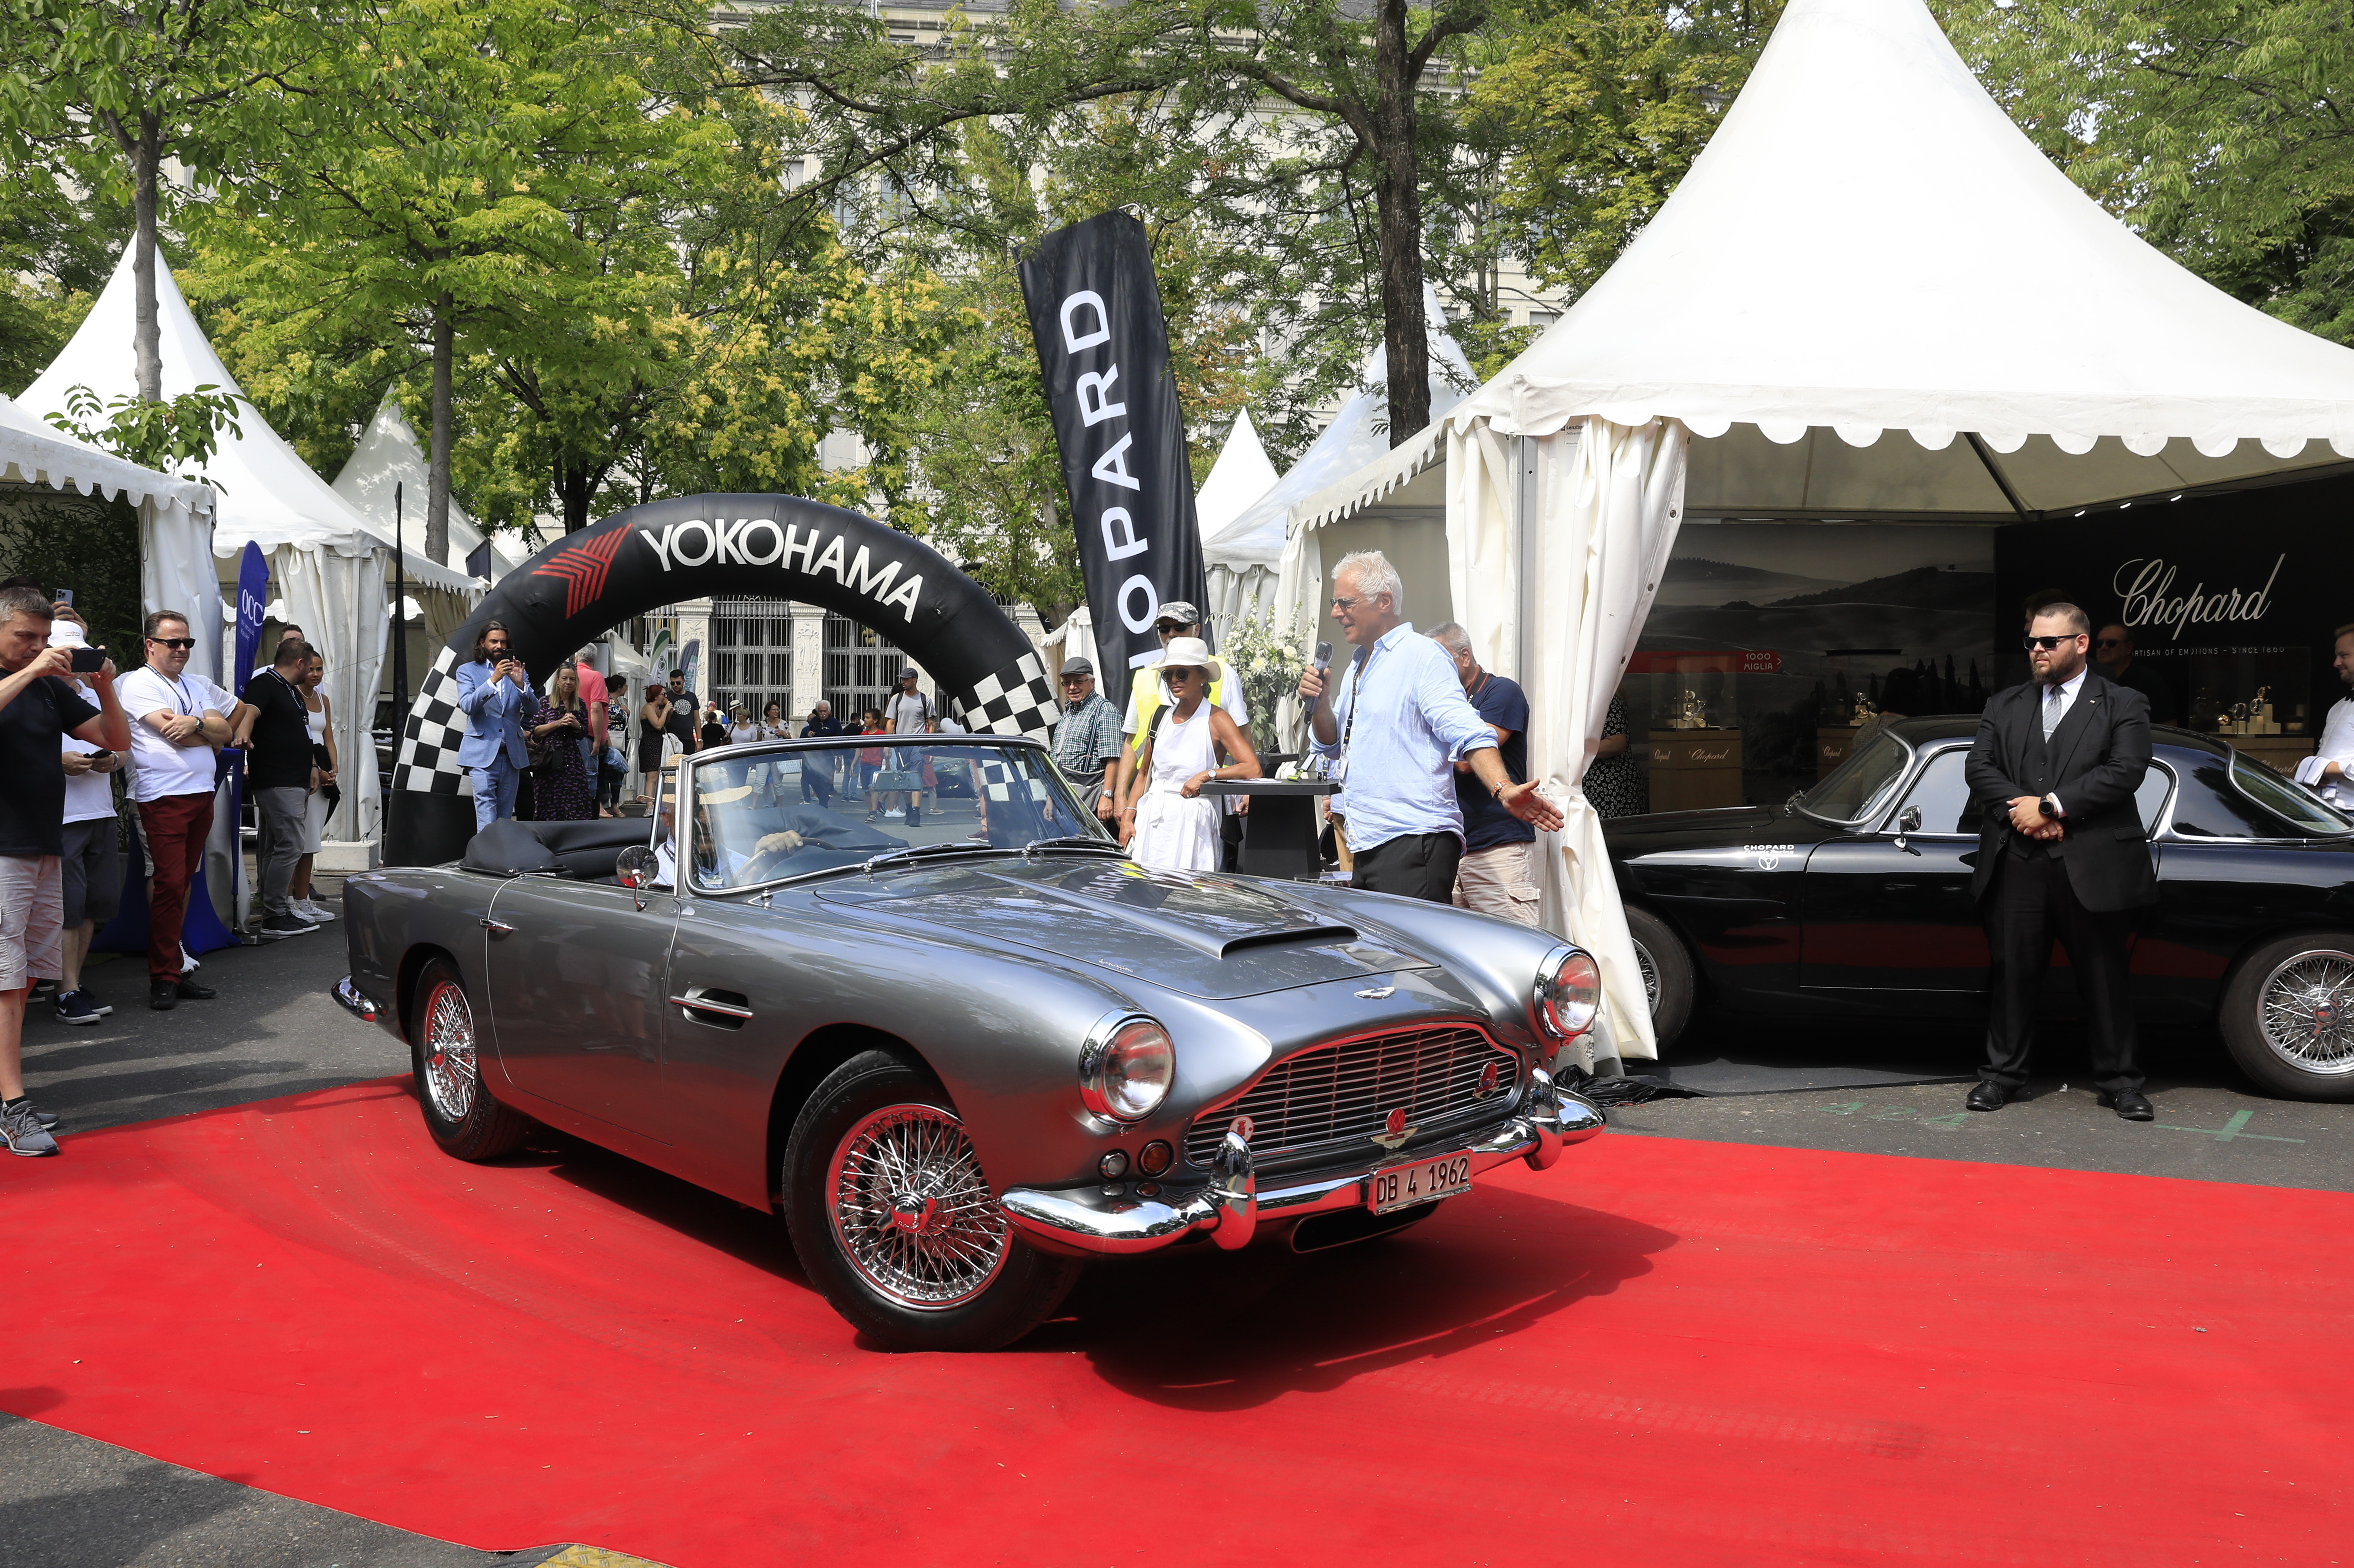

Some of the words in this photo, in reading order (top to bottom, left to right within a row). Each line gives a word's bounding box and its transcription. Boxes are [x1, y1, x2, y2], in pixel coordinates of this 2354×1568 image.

[639, 518, 923, 623] YOKOHAMA
[242, 589, 263, 626] OCC
[2113, 553, 2286, 640] Chopard
[1653, 749, 1671, 762] Chopard
[1688, 749, 1729, 762] Chopard
[1377, 1173, 1398, 1204] DB
[1406, 1169, 1417, 1195] 4
[1428, 1157, 1468, 1191] 1962
